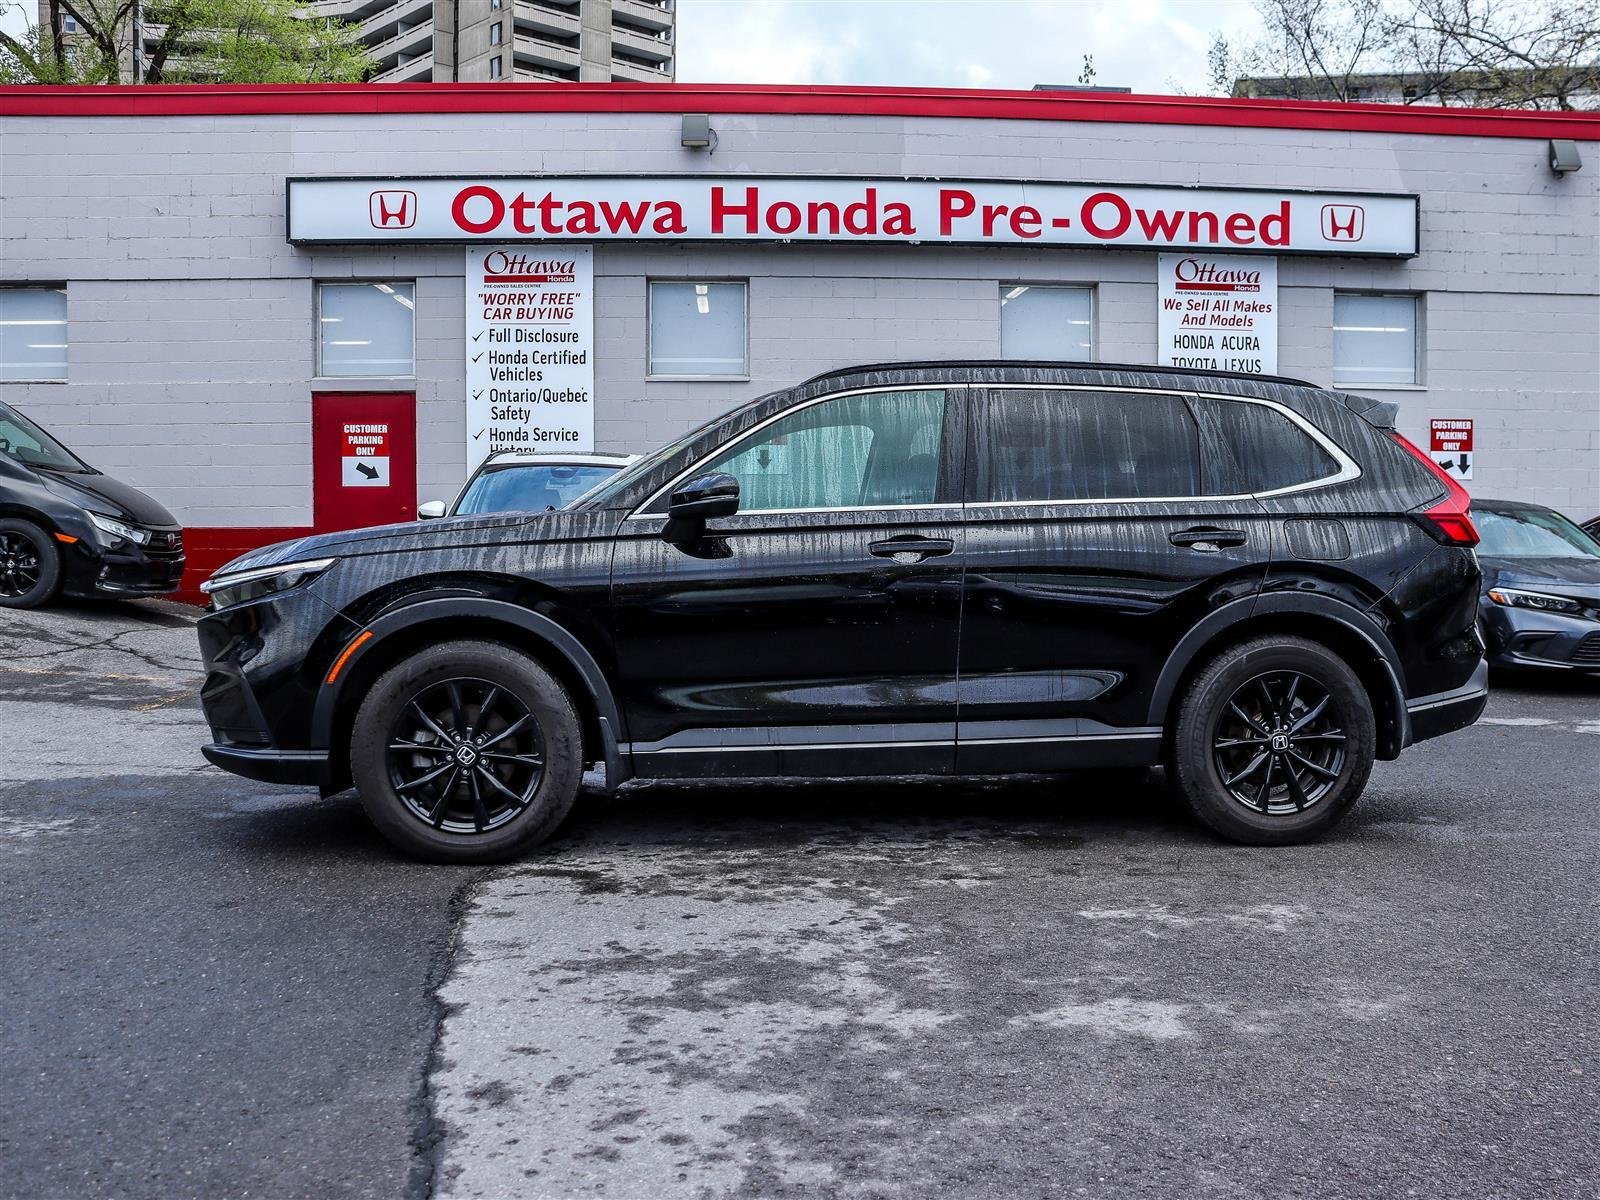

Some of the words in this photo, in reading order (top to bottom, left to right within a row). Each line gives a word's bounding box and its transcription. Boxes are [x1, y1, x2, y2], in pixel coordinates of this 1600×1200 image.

[451, 185, 687, 235] Ottawa
[710, 186, 916, 237] Honda
[940, 188, 1292, 246] Pre-Owned
[483, 250, 576, 274] Ottawa
[1175, 257, 1261, 283] Ottawa
[540, 293, 580, 305] FREE"
[1164, 299, 1182, 311] We
[1186, 299, 1209, 311] Sell
[1212, 299, 1230, 312] All
[1233, 300, 1272, 313] Makes
[483, 308, 512, 320] CAR
[516, 307, 574, 319] BUYING
[1182, 313, 1207, 326] And
[1210, 314, 1253, 327] Models
[489, 329, 511, 343] Full
[515, 328, 579, 343] Disclosure
[1174, 335, 1215, 350] HONDA
[1221, 336, 1260, 351] ACURA
[489, 350, 528, 365] Honda
[532, 350, 586, 365] Certified
[490, 367, 543, 381] Vehicles
[489, 388, 588, 404] Ontario/Quebec
[491, 406, 531, 424] Safety
[344, 424, 388, 433] CUSTOMER
[1432, 421, 1472, 429] CUSTOMER
[348, 436, 383, 444] PARKING
[489, 427, 529, 441] Honda
[533, 427, 579, 441] Service
[1436, 432, 1468, 440] PARKING
[356, 447, 375, 455] ONLY
[1443, 442, 1461, 450] ONLY
